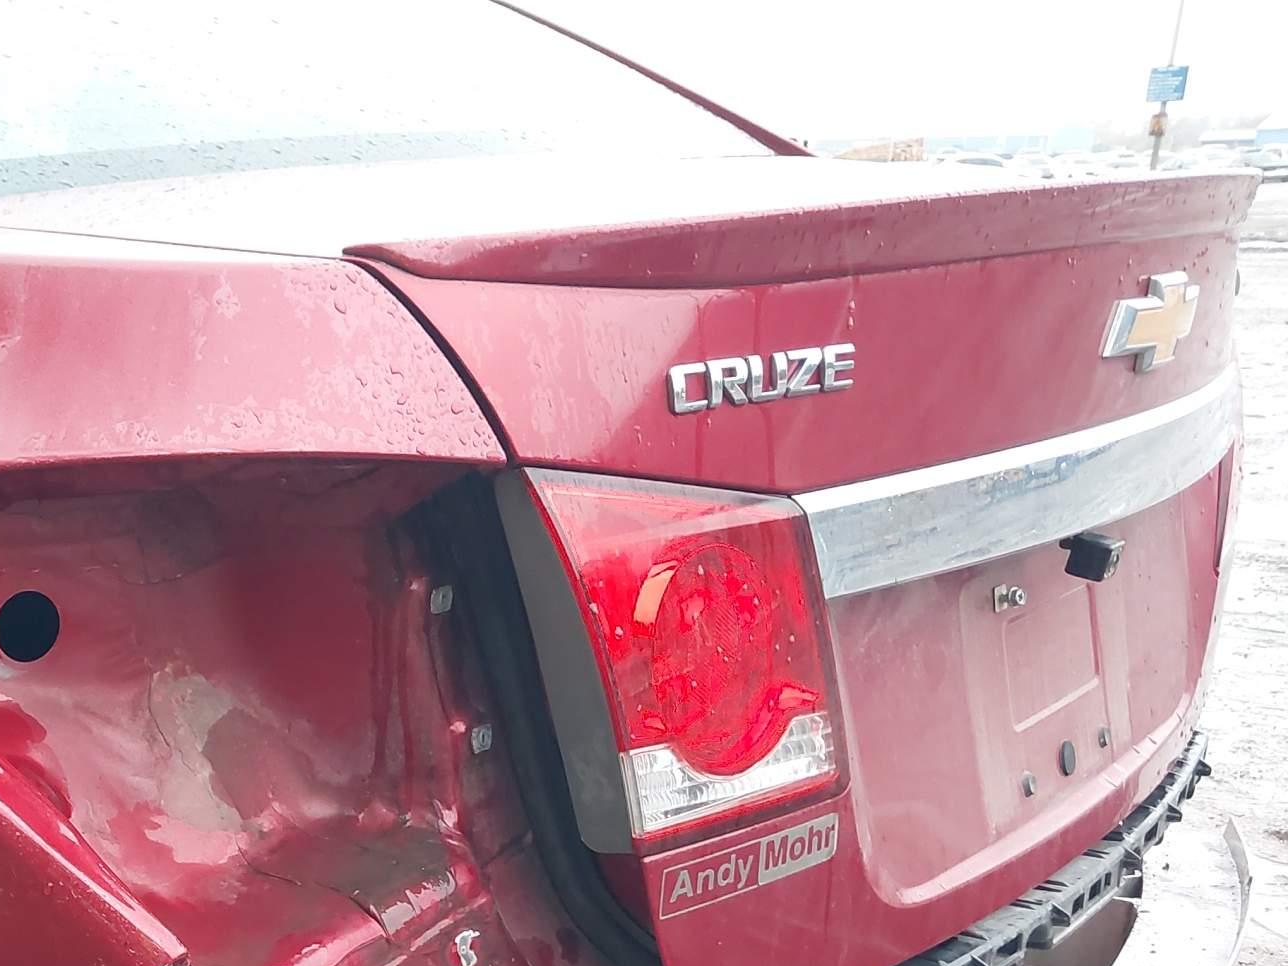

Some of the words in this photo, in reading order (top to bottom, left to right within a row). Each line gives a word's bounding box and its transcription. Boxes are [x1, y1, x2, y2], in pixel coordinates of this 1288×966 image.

[668, 343, 855, 416] CRUZE
[669, 853, 754, 903] Andy
[764, 823, 836, 870] Mohr
